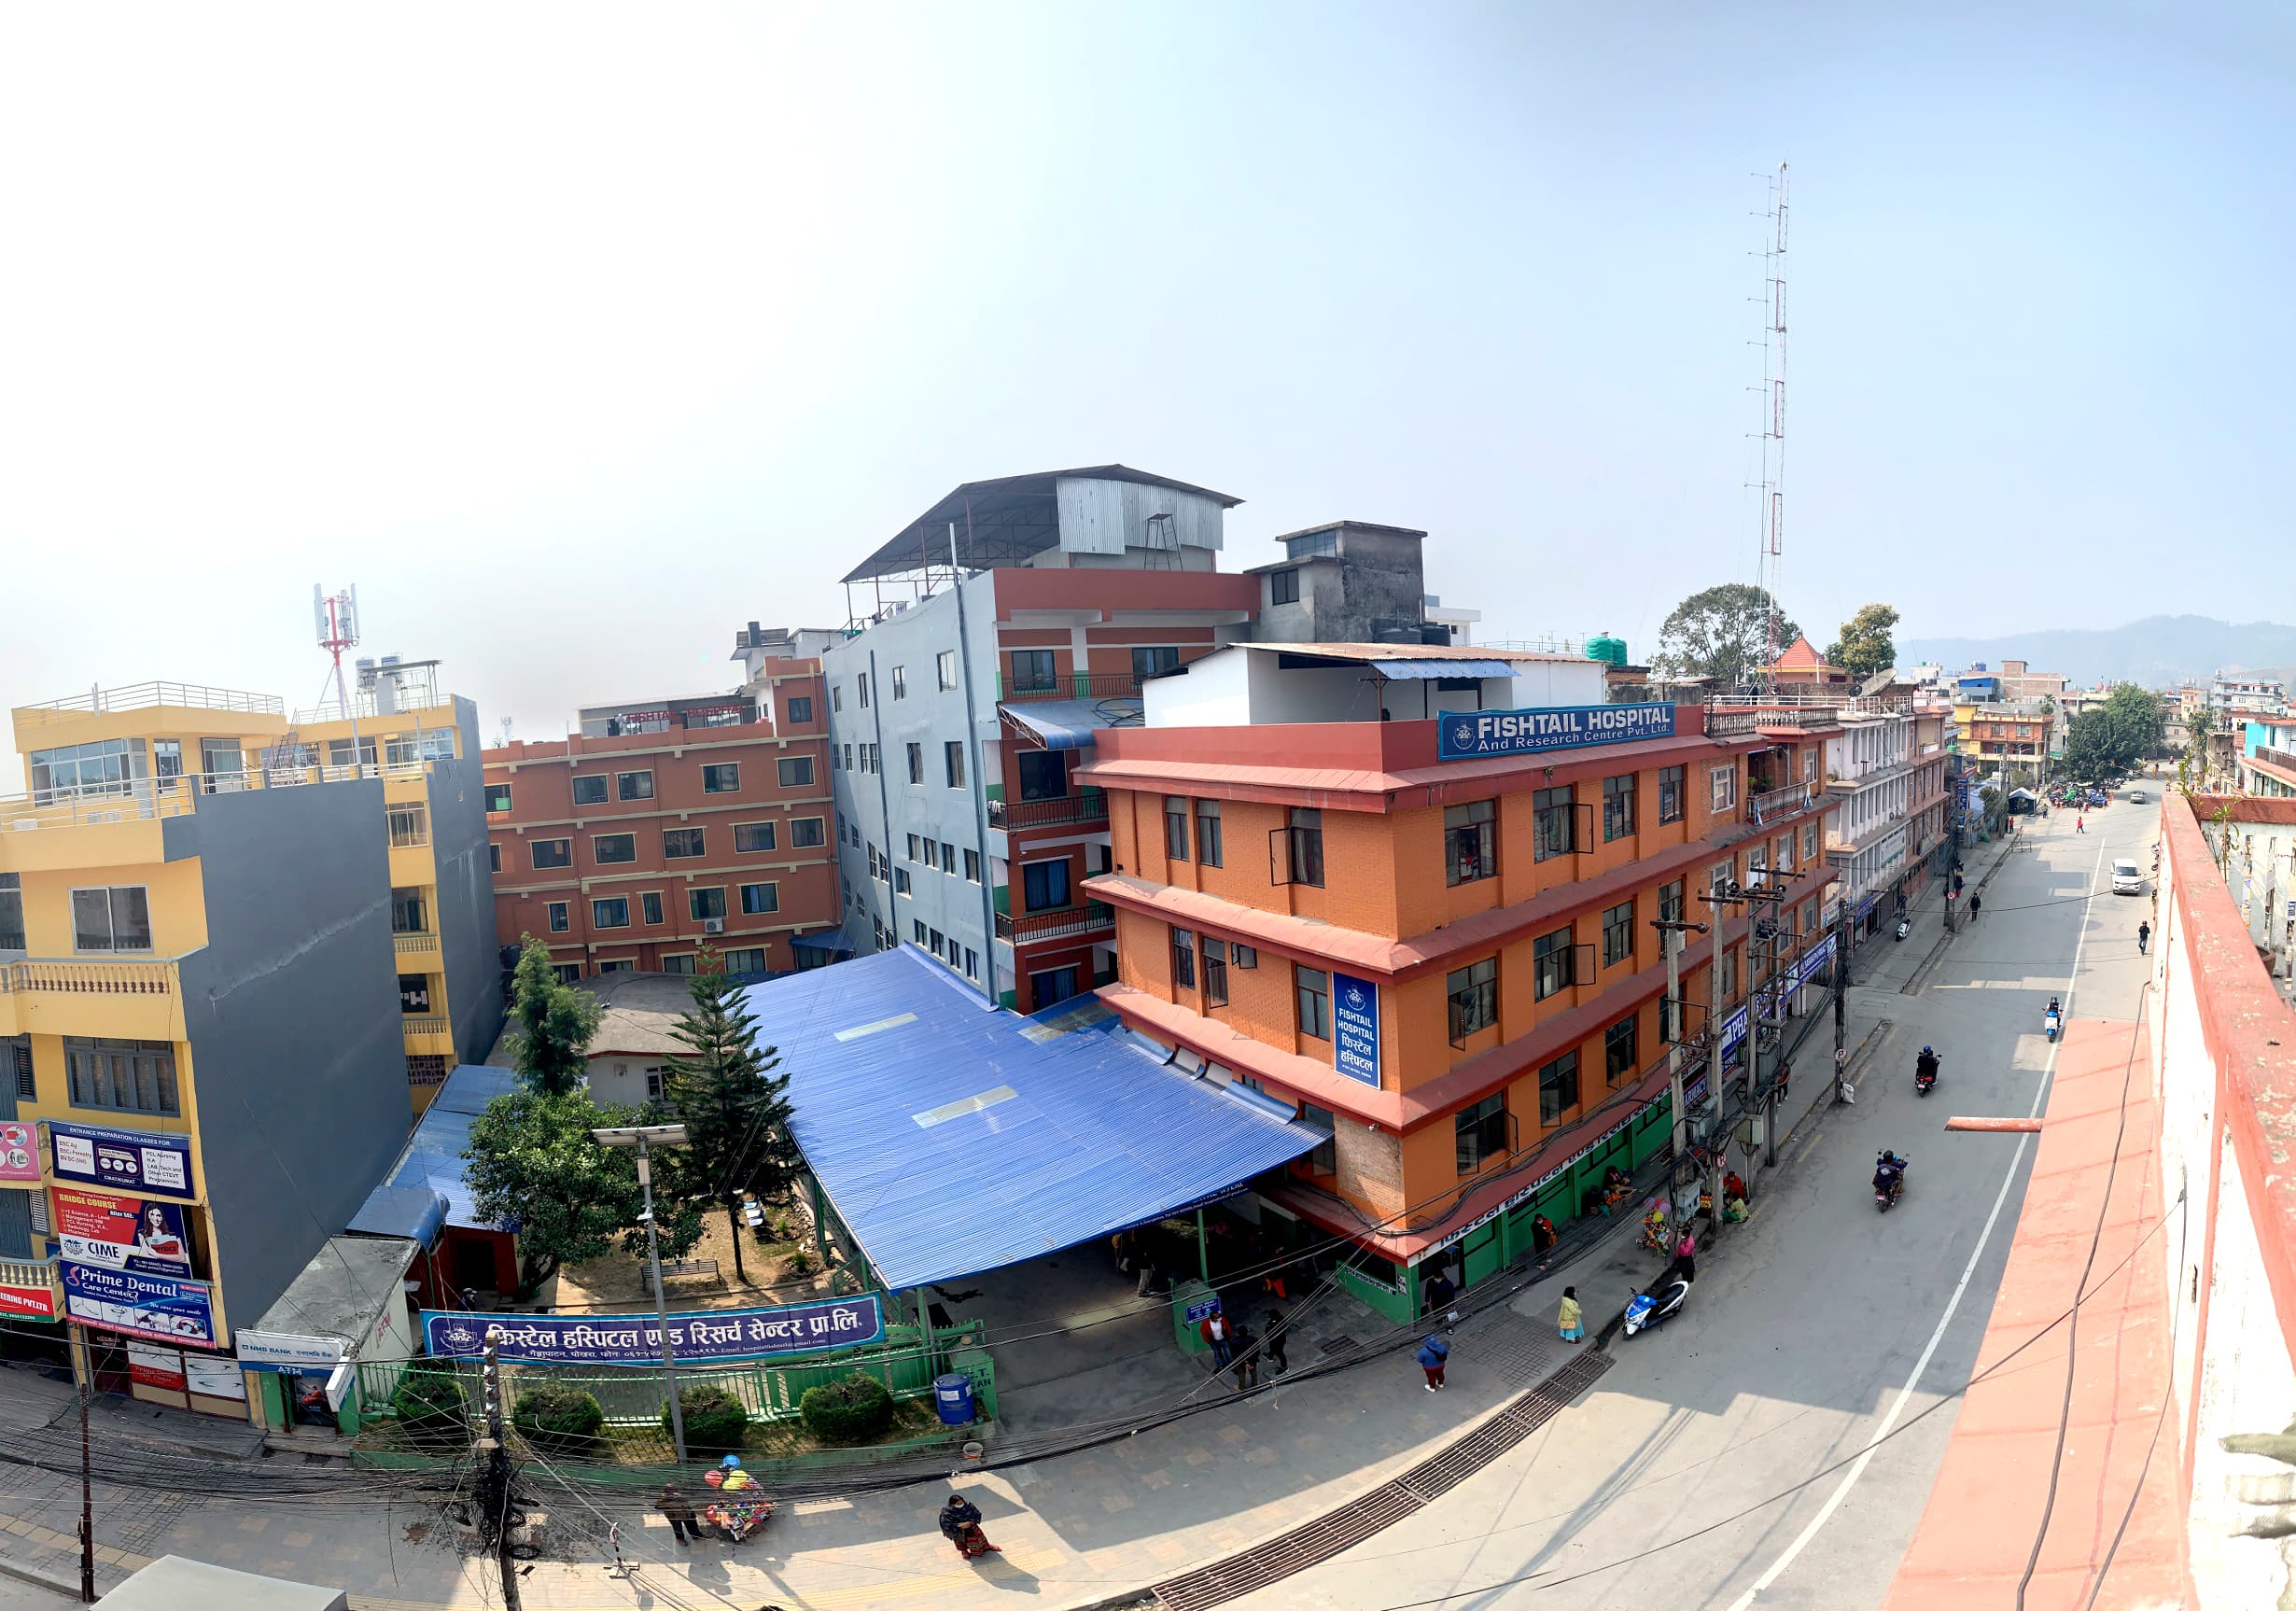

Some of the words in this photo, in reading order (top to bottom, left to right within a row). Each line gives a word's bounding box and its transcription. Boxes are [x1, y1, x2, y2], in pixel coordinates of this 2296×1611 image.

[1477, 713, 1582, 739] FISHTAIL
[1589, 707, 1671, 730] HOSPITAL
[1477, 738, 1509, 751] And
[1516, 733, 1579, 748] Research
[1584, 730, 1623, 741] Centre
[1627, 727, 1648, 736] Pvt.
[1651, 723, 1670, 734] Ltd.
[1338, 1008, 1373, 1029] FISHTAIL
[1337, 1019, 1375, 1042] HOSPITAL
[69, 1127, 96, 1136] ENTRANCE
[96, 1130, 133, 1142] PREPARATION
[133, 1136, 158, 1145] CLASSES
[59, 1193, 86, 1205] BRIDGE
[87, 1197, 117, 1210] COURSE
[88, 1241, 120, 1259] CIME
[80, 1267, 123, 1287] Prime
[127, 1276, 177, 1297] Dental
[82, 1282, 102, 1293] Care
[562, 1324, 638, 1349] हस्पिटल
[690, 1320, 742, 1345] रिसर्च
[748, 1318, 804, 1341] सेन्टर
[269, 1347, 292, 1355] BANK
[278, 1366, 302, 1376] ATM
